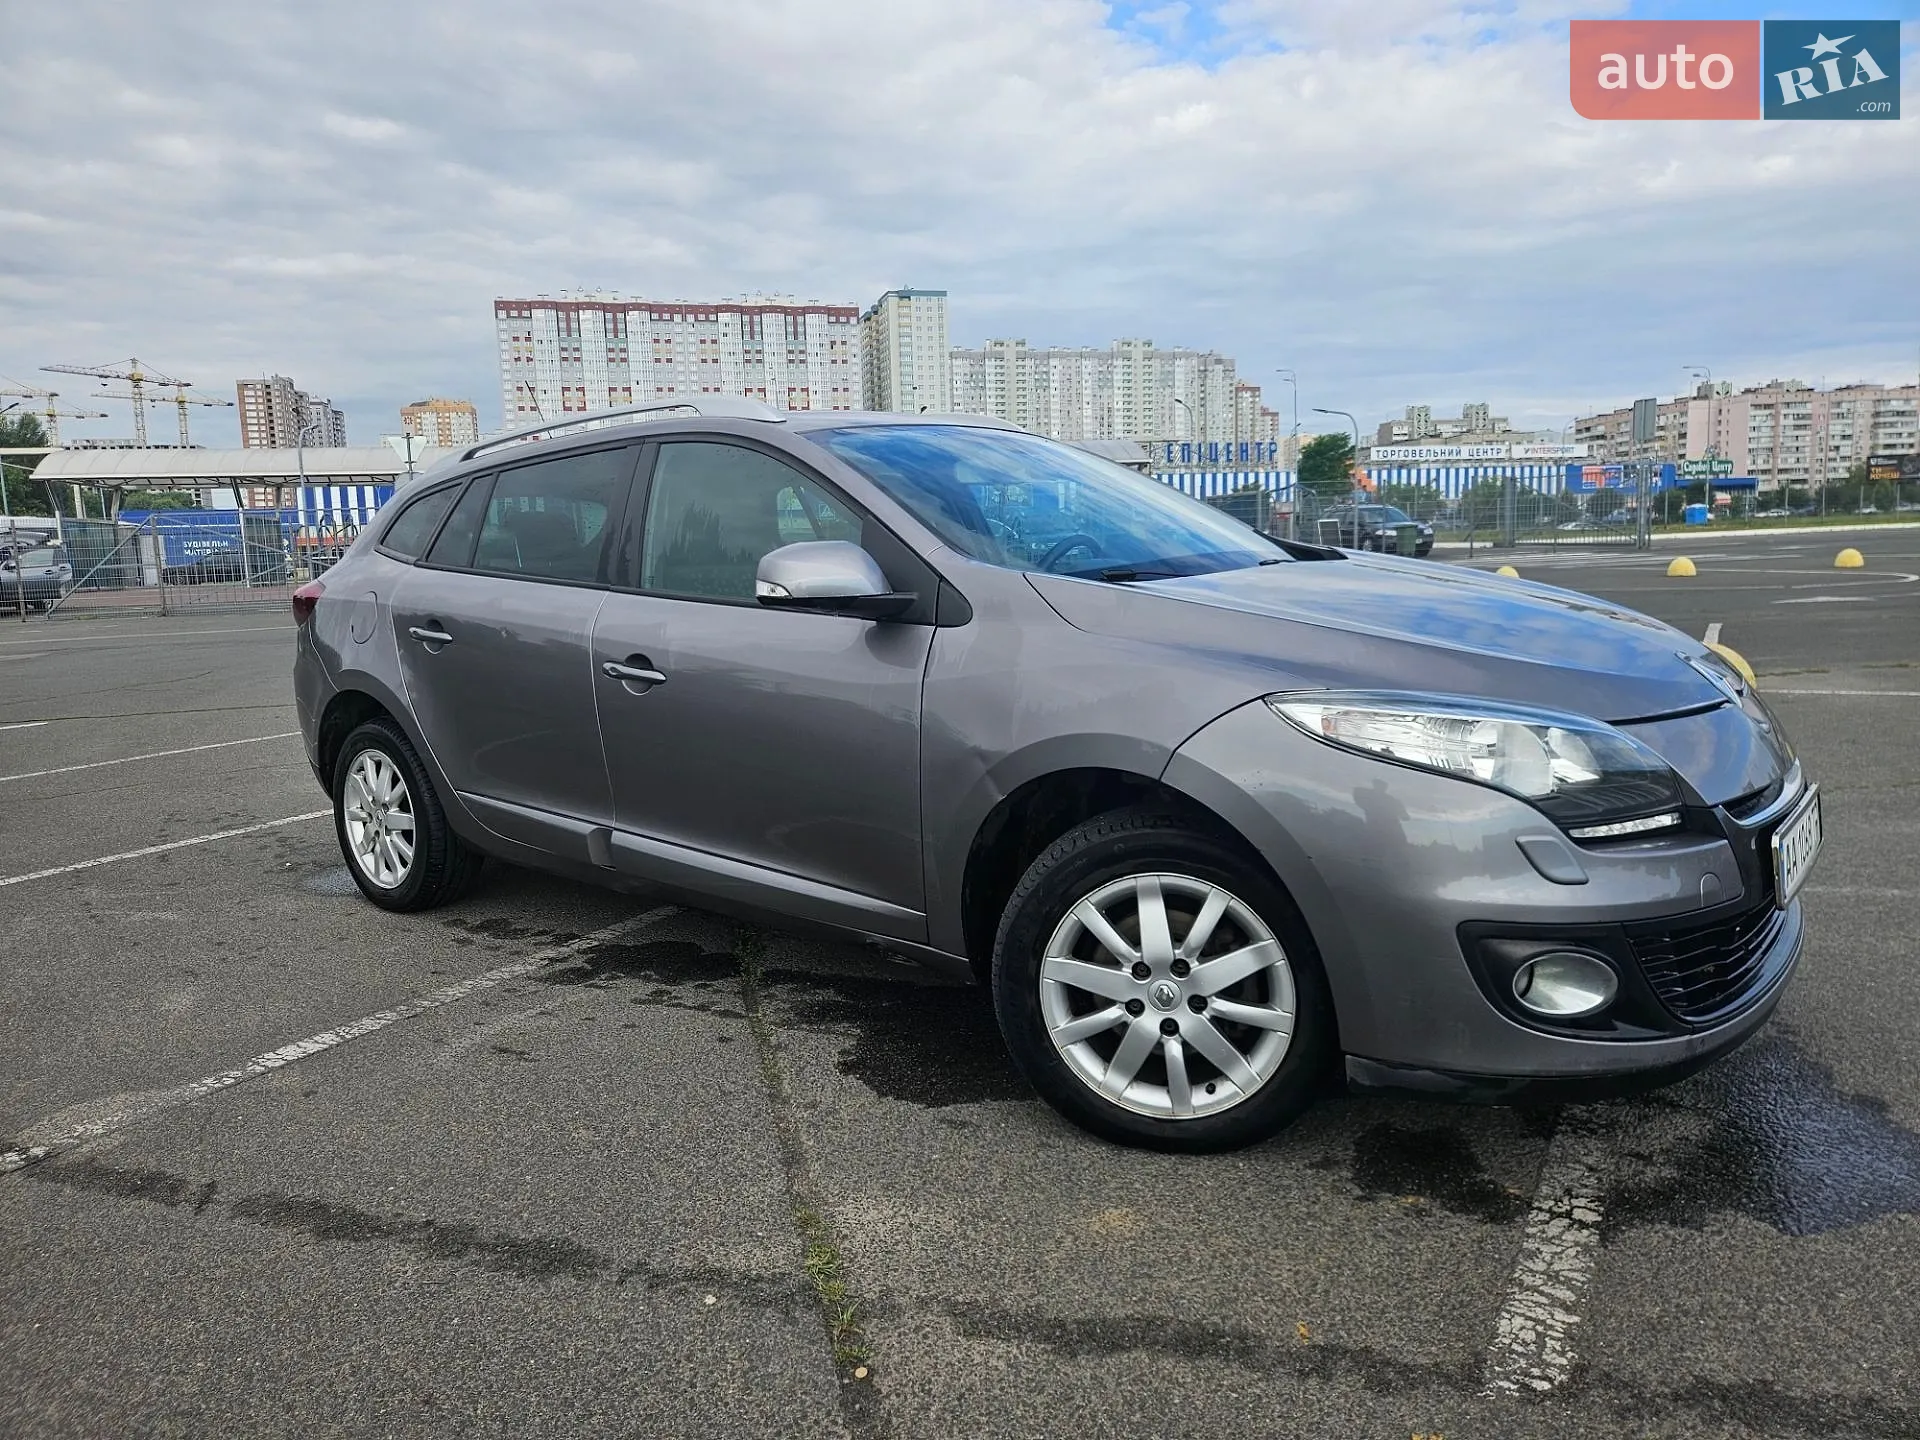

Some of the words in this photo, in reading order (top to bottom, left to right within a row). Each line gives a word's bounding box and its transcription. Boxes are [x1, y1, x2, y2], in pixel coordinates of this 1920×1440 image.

[1167, 442, 1278, 463] ЕПІЦЕНТР
[1375, 446, 1462, 459] ТОРГОВЕЛЬНИЙ
[1468, 447, 1502, 459] ЦЕНТР
[1531, 446, 1575, 455] INTERSPORT
[1712, 460, 1732, 474] Центр
